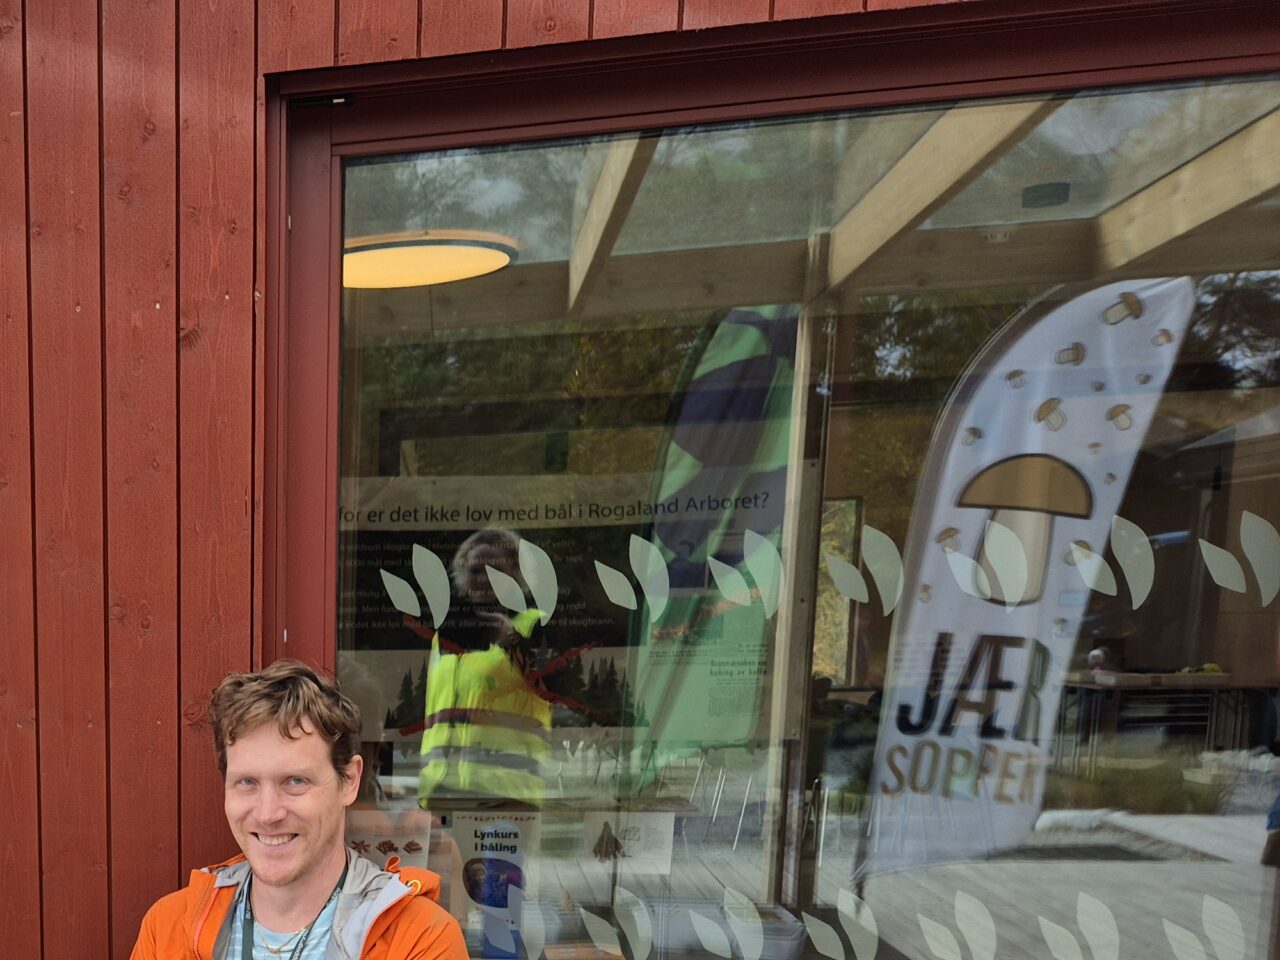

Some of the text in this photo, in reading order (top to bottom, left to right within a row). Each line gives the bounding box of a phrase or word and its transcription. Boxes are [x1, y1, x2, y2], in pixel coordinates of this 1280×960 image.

[367, 510, 386, 523] er
[389, 505, 419, 523] det
[424, 505, 460, 522] ikke
[466, 505, 493, 522] lov
[498, 504, 539, 522] med
[545, 502, 573, 521] bål
[588, 498, 679, 521] Rogaland
[685, 492, 770, 513] Arboret?
[896, 631, 1052, 745] JÆR
[473, 829, 519, 841] Lynkurs
[480, 842, 518, 854] båling
